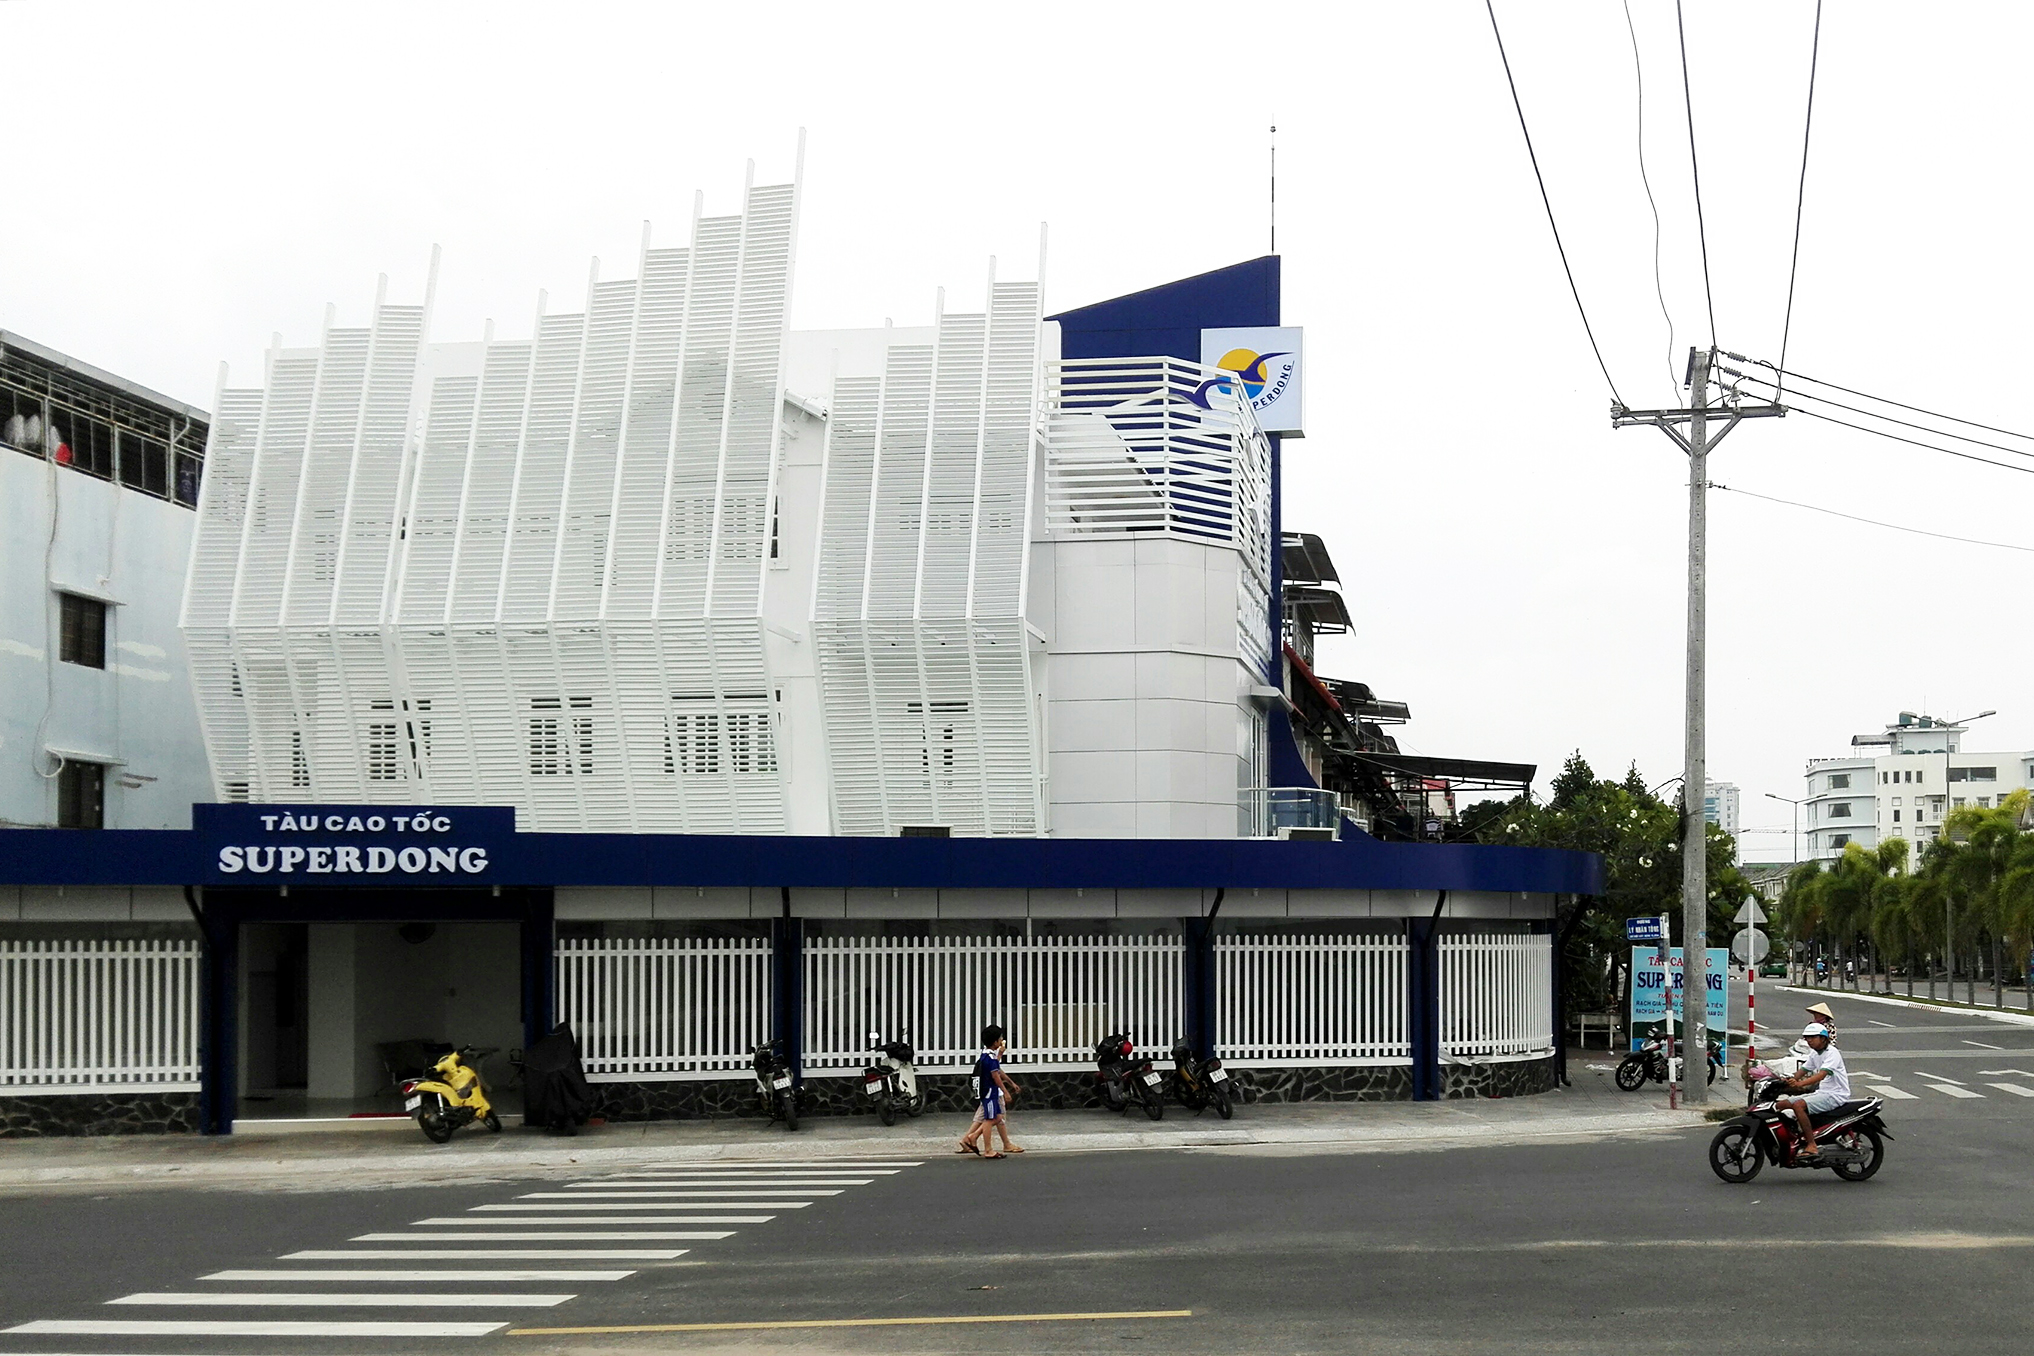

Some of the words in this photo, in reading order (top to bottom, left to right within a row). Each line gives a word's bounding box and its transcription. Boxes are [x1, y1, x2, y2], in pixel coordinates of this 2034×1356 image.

[260, 811, 319, 832] TÀU
[324, 815, 387, 833] CAO
[392, 810, 452, 833] TỐC
[218, 845, 489, 874] SUPERDONG
